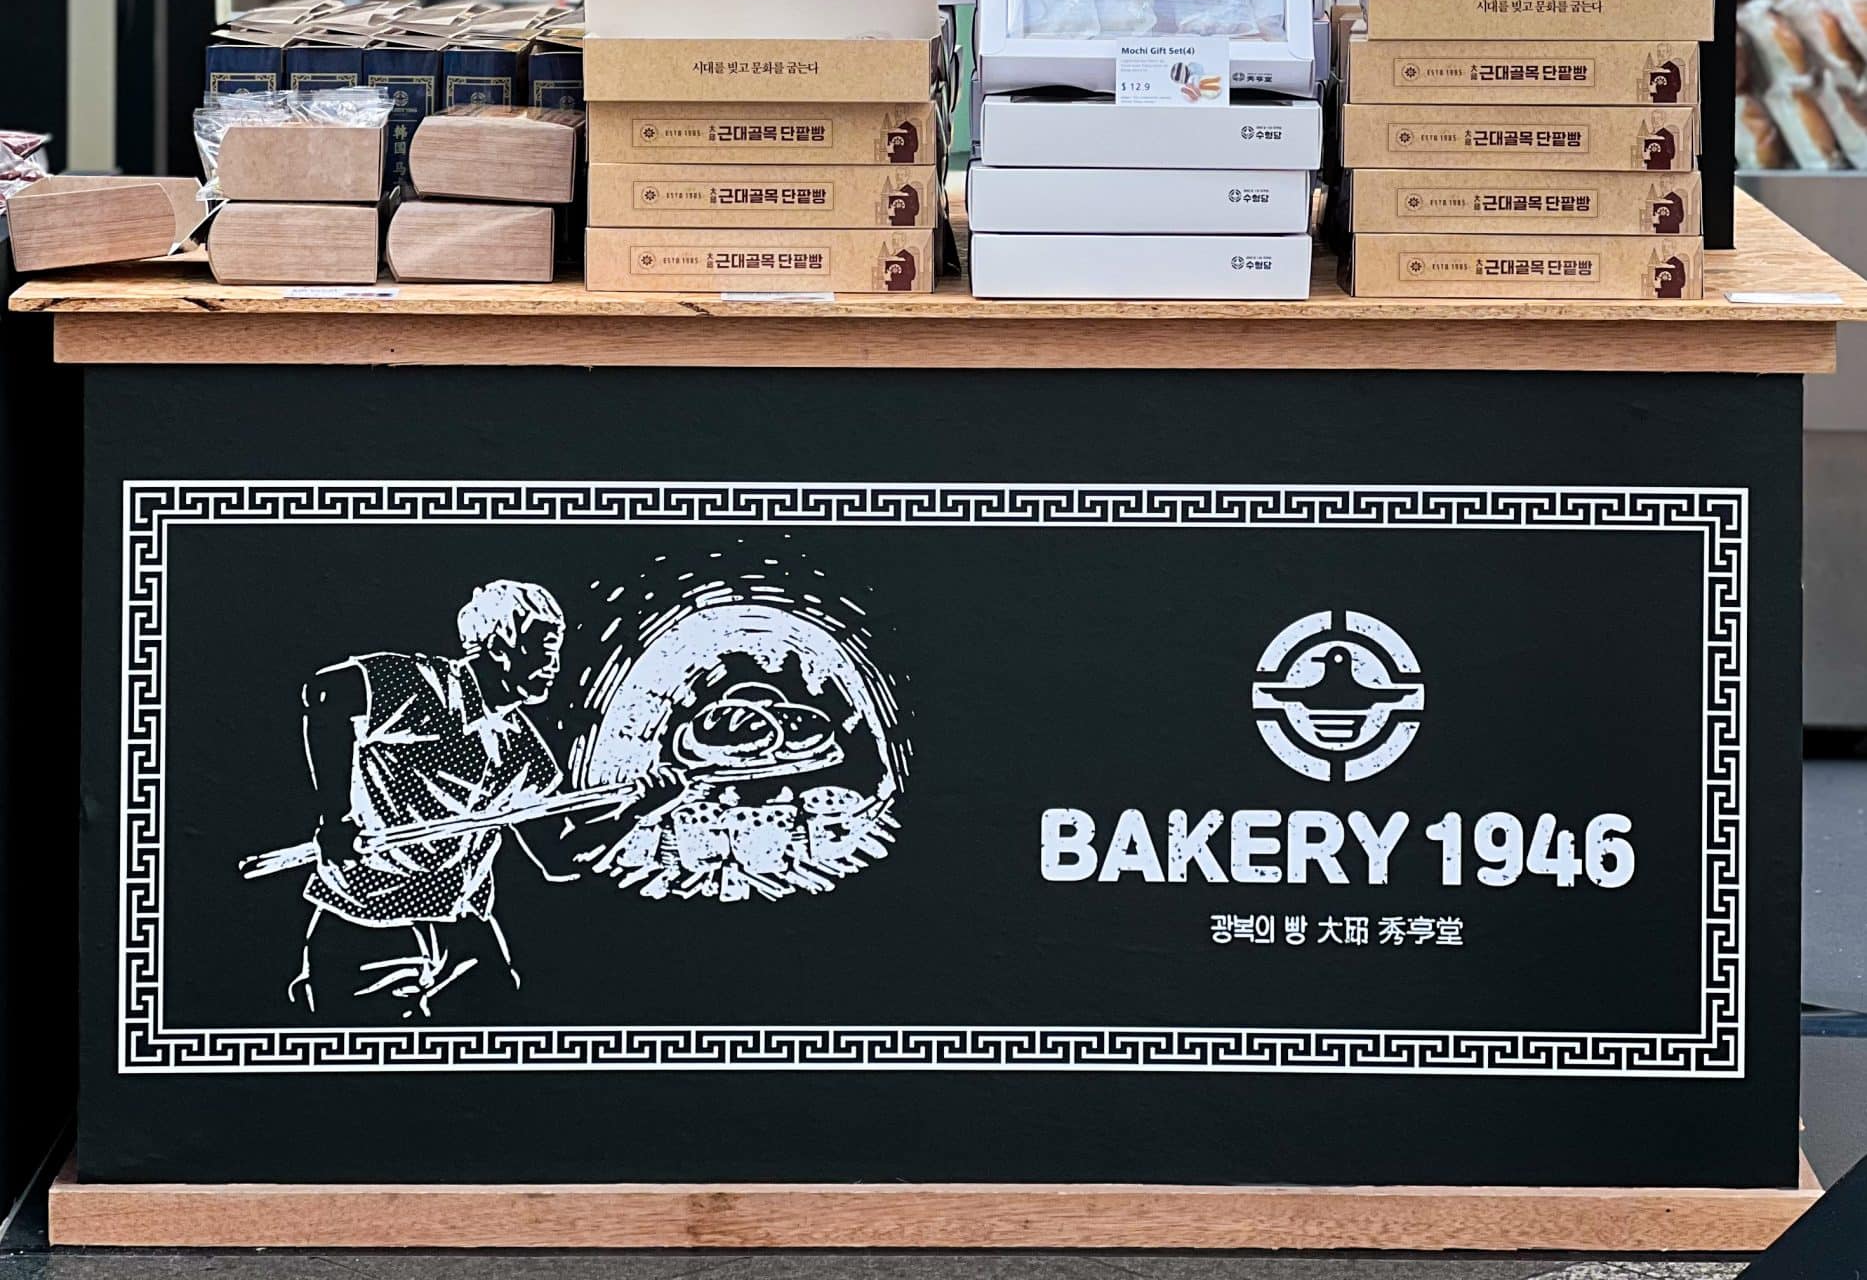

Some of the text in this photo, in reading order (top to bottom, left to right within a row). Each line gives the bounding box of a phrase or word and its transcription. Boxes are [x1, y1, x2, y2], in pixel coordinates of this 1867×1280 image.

[1477, 0, 1509, 14] 시대를
[1536, 0, 1569, 14] 문화를
[1570, 0, 1602, 14] 굽는다
[1121, 47, 1195, 56] Mochi Gift Set(4)
[693, 61, 725, 75] 시대를
[752, 61, 785, 75] 문화를
[786, 61, 818, 75] 굽는다
[1480, 65, 1539, 81] 근대골목
[1542, 65, 1588, 81] 단팥빵
[718, 126, 777, 142] 근대골목
[780, 126, 826, 142] 단팥빵
[1474, 130, 1533, 147] 근대골목
[1536, 130, 1582, 147] 단팥빵
[718, 188, 778, 204] 근대골목
[782, 188, 826, 204] 단팥빵
[1482, 195, 1542, 212] 근대골목
[1546, 195, 1591, 212] 단팥빵
[715, 253, 775, 269] 근대골목
[778, 253, 823, 269] 단팥빵
[1485, 259, 1544, 276] 근대골목
[1548, 259, 1593, 276] 단팥빵
[1040, 808, 1635, 889] BAKERY 1946
[1210, 914, 1275, 944] 광복의
[1284, 915, 1309, 946] 빵
[1377, 915, 1464, 946] 秀亨堂
